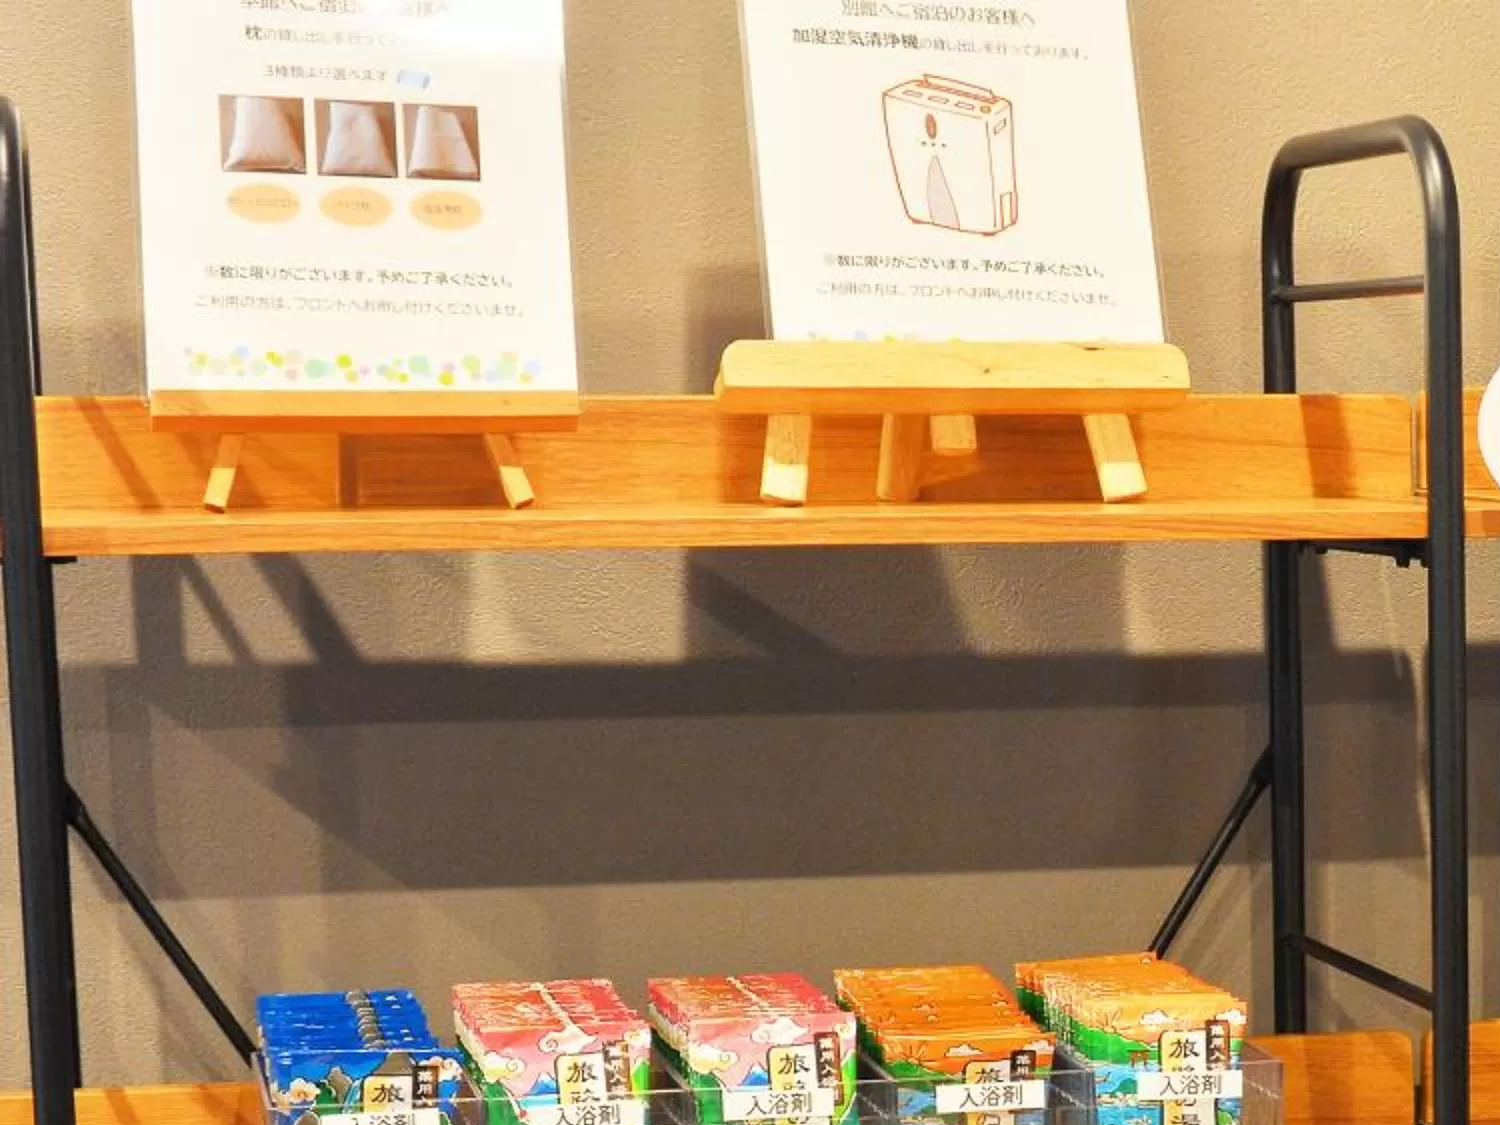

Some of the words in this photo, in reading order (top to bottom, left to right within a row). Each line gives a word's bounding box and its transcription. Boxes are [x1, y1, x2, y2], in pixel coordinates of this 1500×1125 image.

[959, 1084, 1023, 1108] 入浴剤
[1159, 1073, 1222, 1096] 入浴剤
[746, 1092, 813, 1116] 入浴剤
